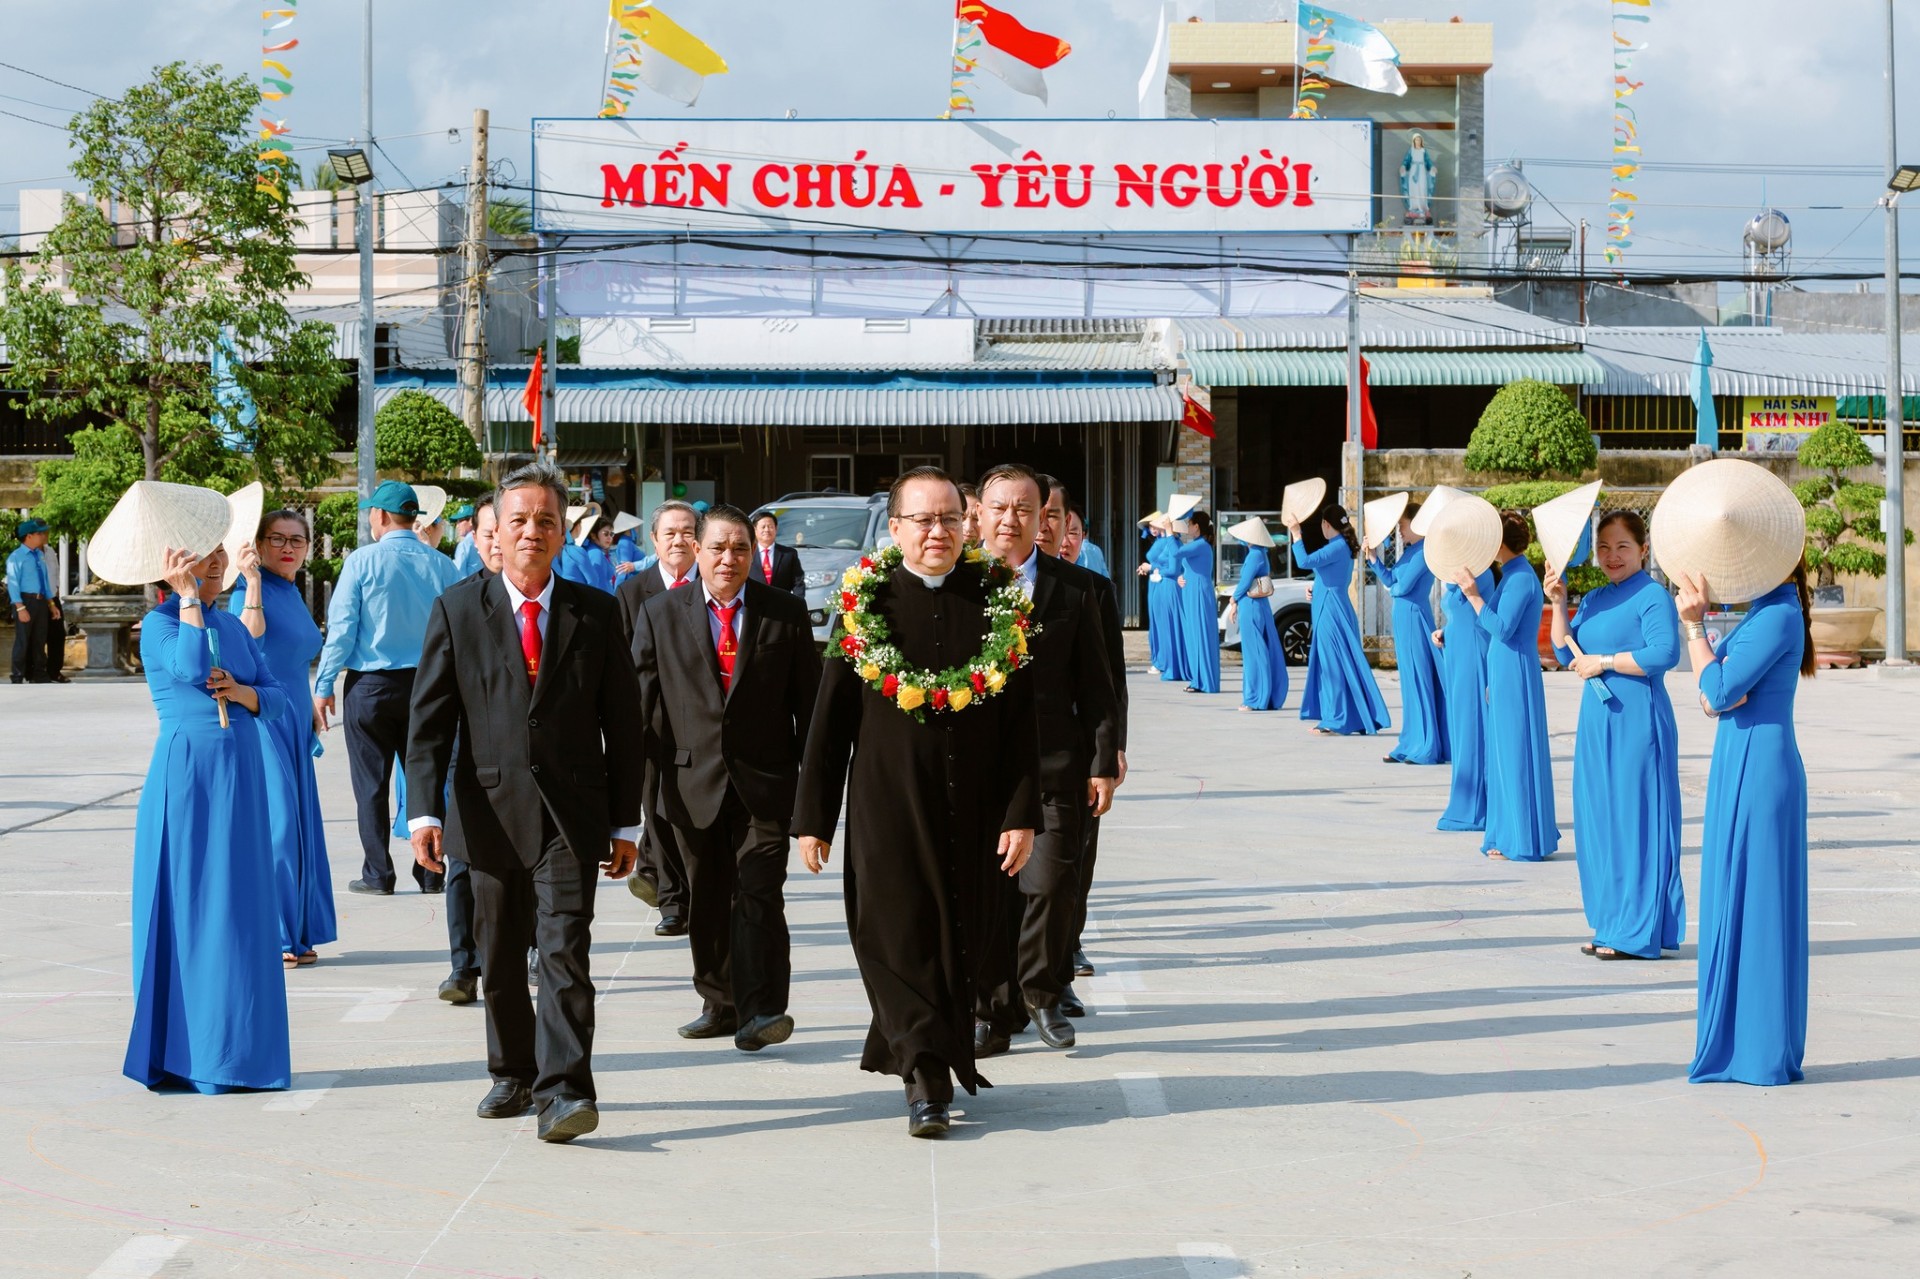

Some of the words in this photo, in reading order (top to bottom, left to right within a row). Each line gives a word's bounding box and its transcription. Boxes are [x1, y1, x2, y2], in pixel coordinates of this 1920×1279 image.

[600, 141, 731, 207] MẾN
[752, 150, 921, 207] CHÚA
[939, 184, 954, 194] -
[970, 150, 1094, 207] YÊU
[1114, 149, 1313, 207] NGƯỜI
[1750, 412, 1787, 427] KIM
